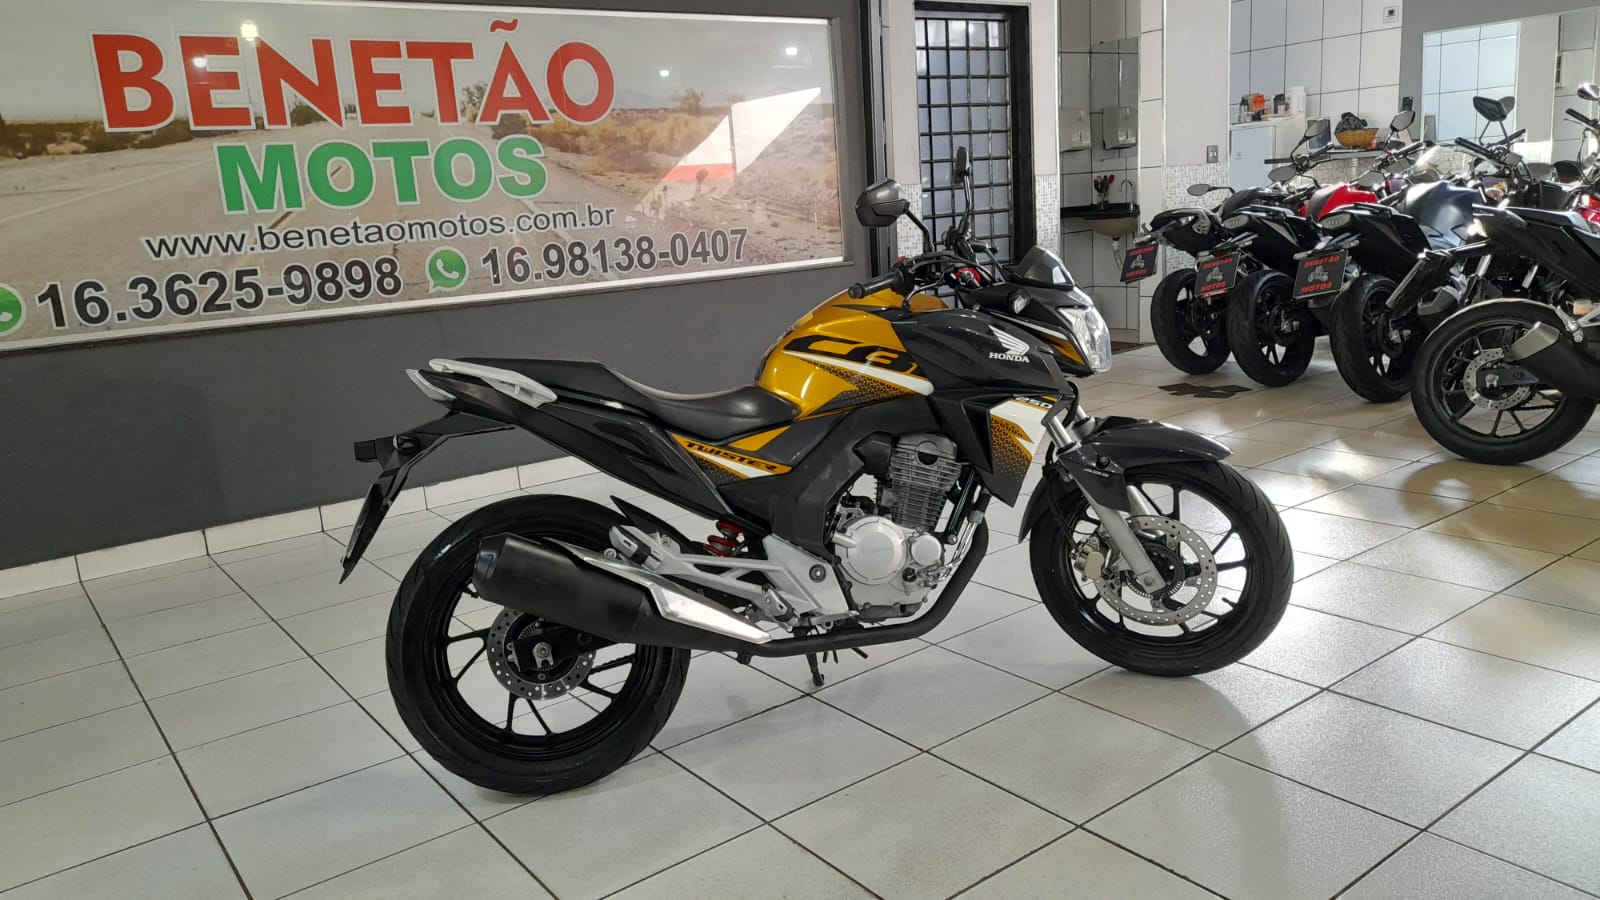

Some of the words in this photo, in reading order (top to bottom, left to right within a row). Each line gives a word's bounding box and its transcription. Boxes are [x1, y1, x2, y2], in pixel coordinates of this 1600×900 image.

[92, 18, 615, 129] BENETÃO
[216, 136, 547, 213] MOTOS
[145, 205, 615, 258] www.benetaomotos.com.br
[482, 228, 748, 284] 16.98138-0407
[37, 257, 401, 328] 16.3625-9898
[1301, 282, 1333, 293] MOTOS
[989, 351, 1030, 363] HONDA
[685, 440, 778, 471] TWISTER
